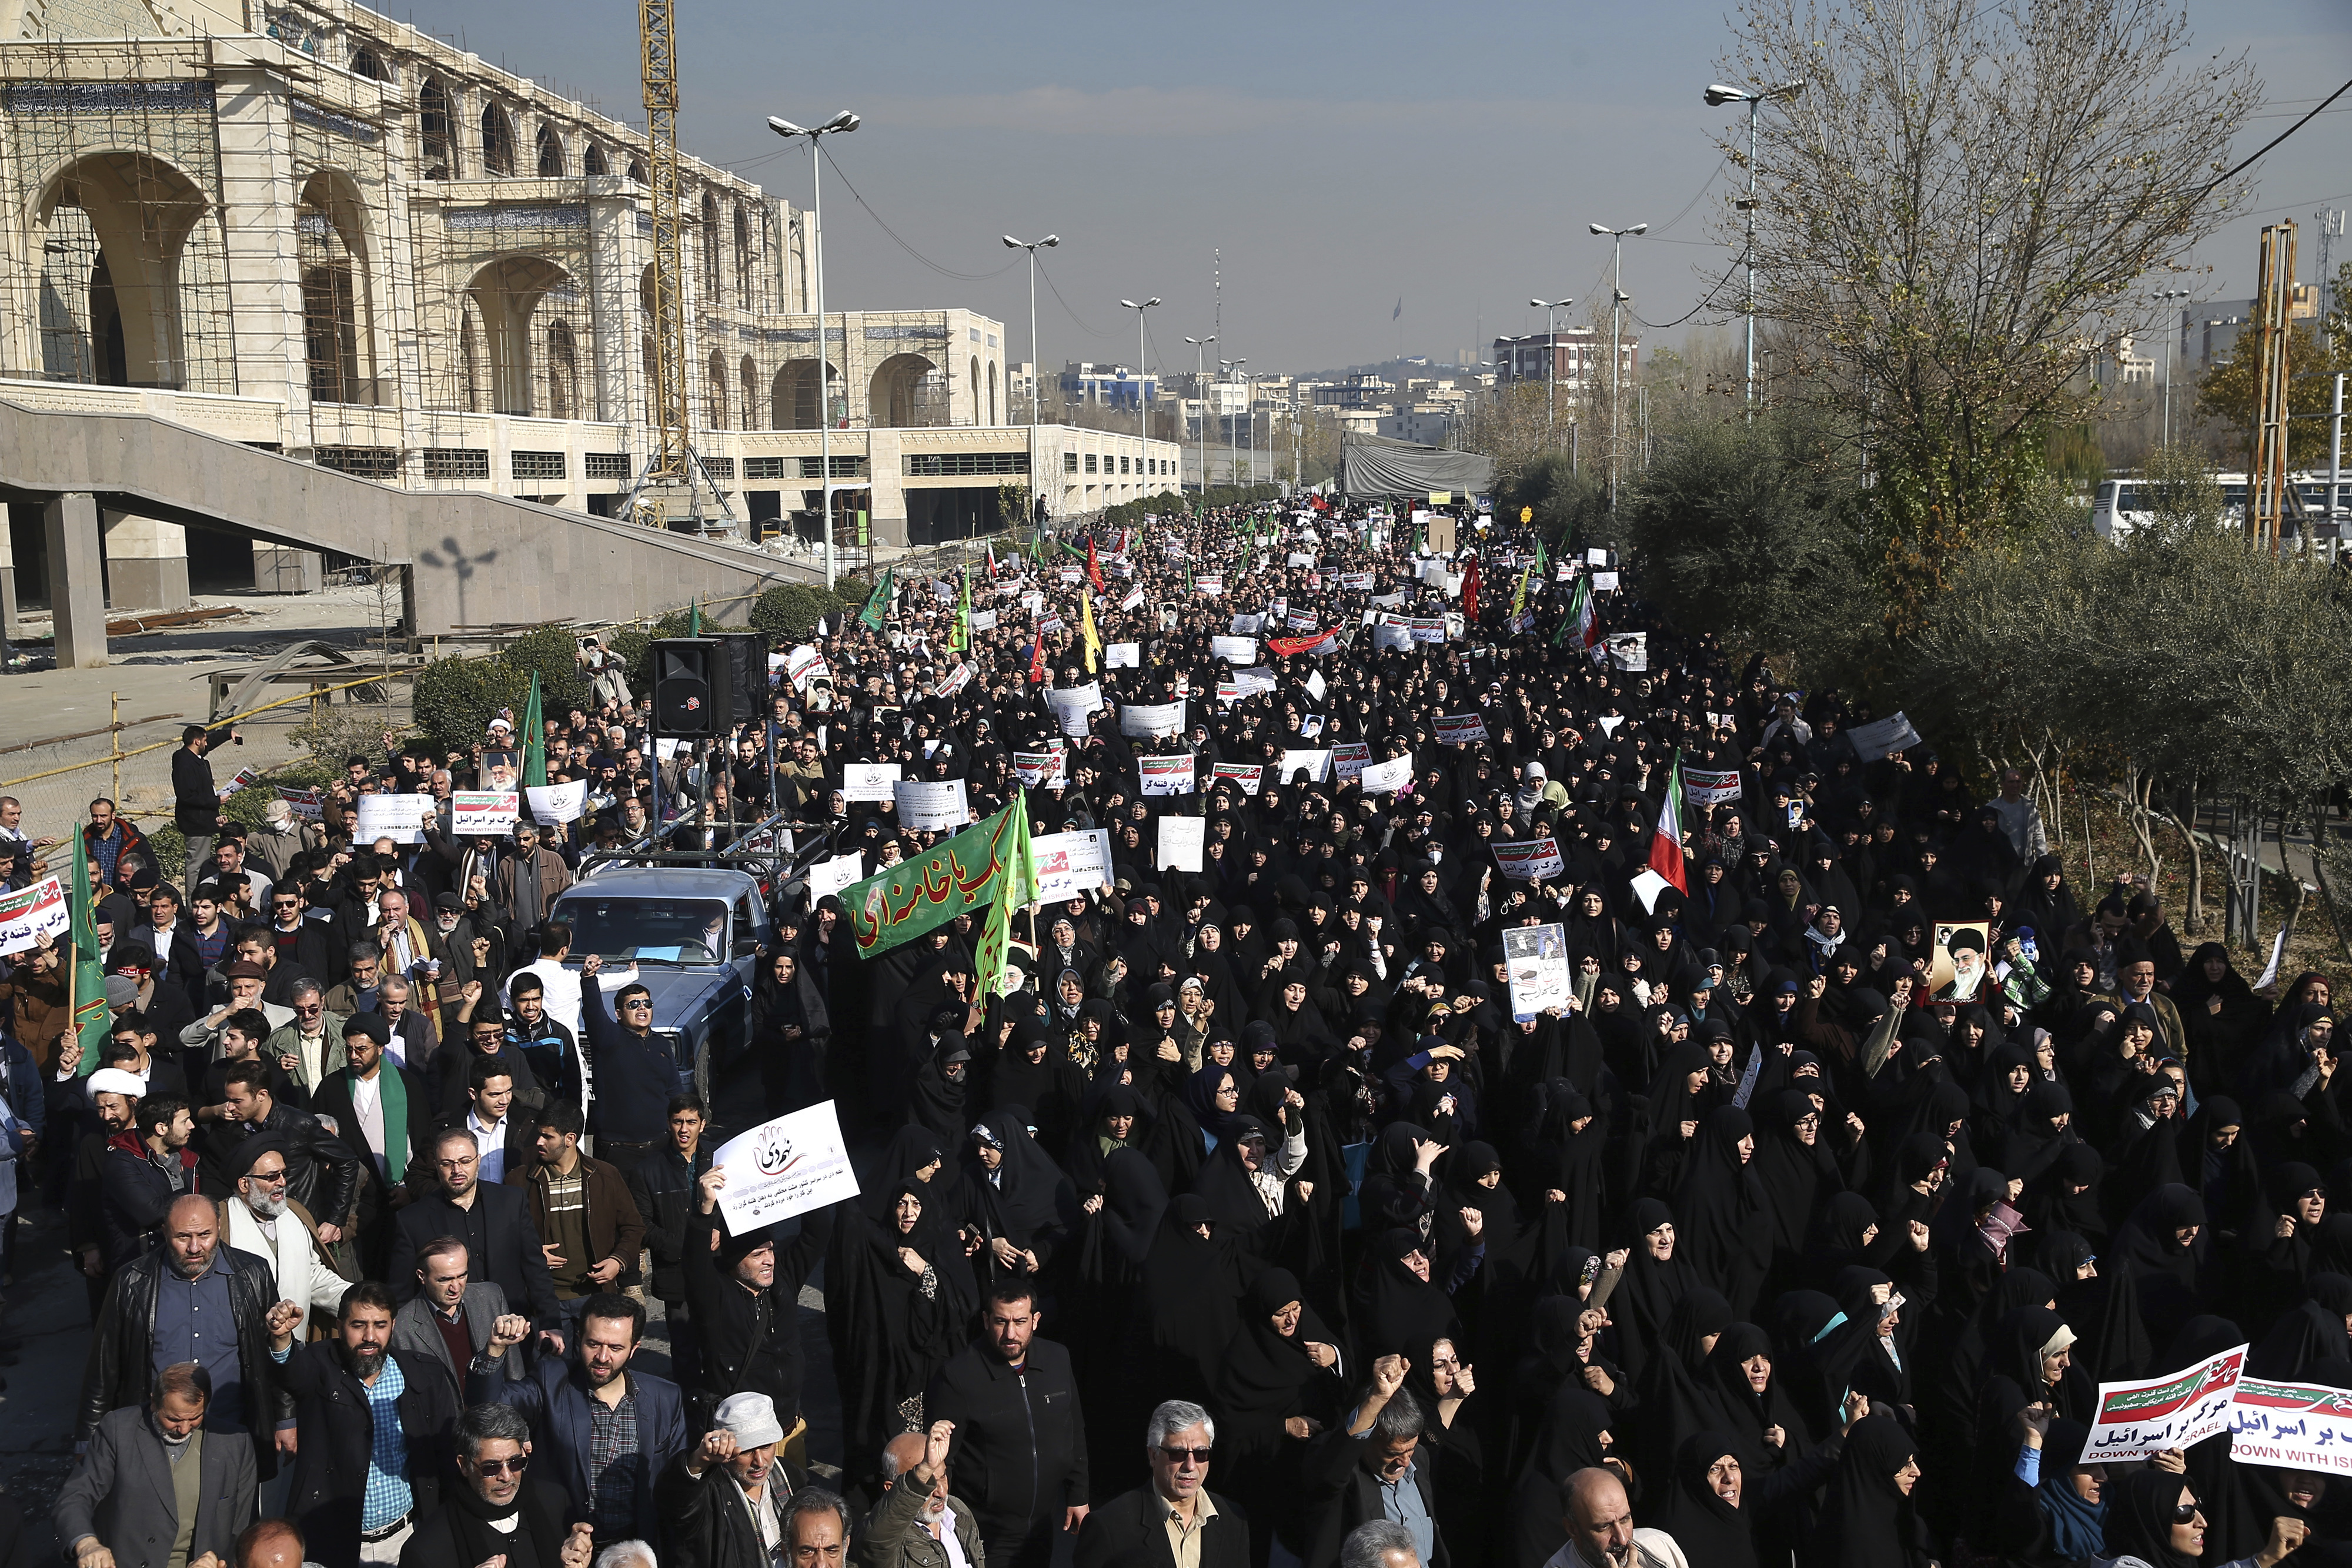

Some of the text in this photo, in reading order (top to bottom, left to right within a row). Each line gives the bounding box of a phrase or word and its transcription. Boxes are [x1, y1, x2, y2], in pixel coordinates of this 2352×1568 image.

[1338, 764, 1352, 773] اسرائیل
[1144, 780, 1152, 790] گر
[1154, 779, 1167, 787] فتنه
[1177, 778, 1192, 788] مرگ
[1689, 788, 1710, 800] اسرائیل
[456, 815, 485, 825] اسرائیل
[1504, 861, 1561, 874] مرگ بر اسرائیل
[1040, 878, 1072, 892] مرگ بر
[46, 912, 65, 927] مرگ
[10, 924, 32, 939] فتنه
[799, 1180, 808, 1188] کشور
[774, 1188, 787, 1198] محکمی
[739, 1201, 747, 1209] گران
[2169, 1383, 2183, 1392] تجلی
[2176, 1386, 2191, 1398] شکست
[2141, 1390, 2156, 1398] قدرت
[2094, 1399, 2227, 1447] مرگ بر اسرائیل
[2228, 1410, 2306, 1439] اسرائیل
[2315, 1427, 2334, 1446] بر
[2088, 1450, 2138, 1459] DOWN
[2286, 1450, 2328, 1465] WITH
